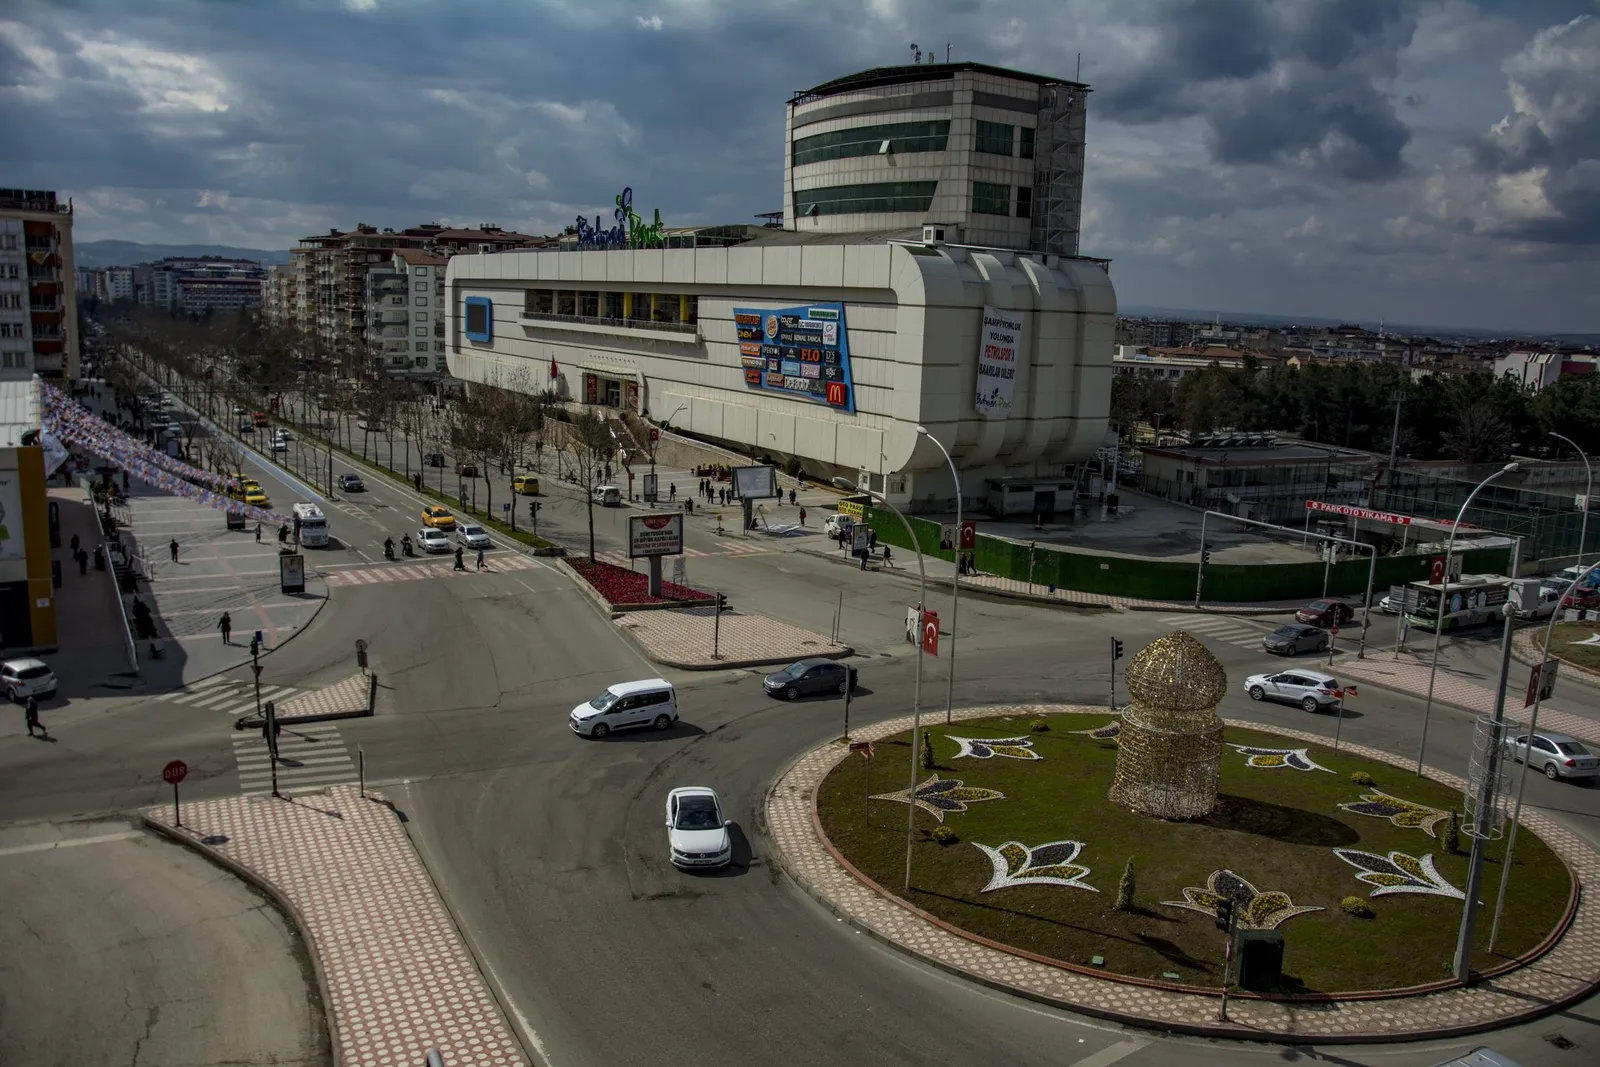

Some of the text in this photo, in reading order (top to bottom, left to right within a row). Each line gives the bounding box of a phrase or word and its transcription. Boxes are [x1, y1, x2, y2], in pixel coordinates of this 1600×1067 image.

[990, 332, 1014, 343] YOLUNDA
[801, 348, 820, 362] FLO
[1321, 502, 1392, 523] PARK OTO YIKAMA
[165, 766, 185, 779] DUR
